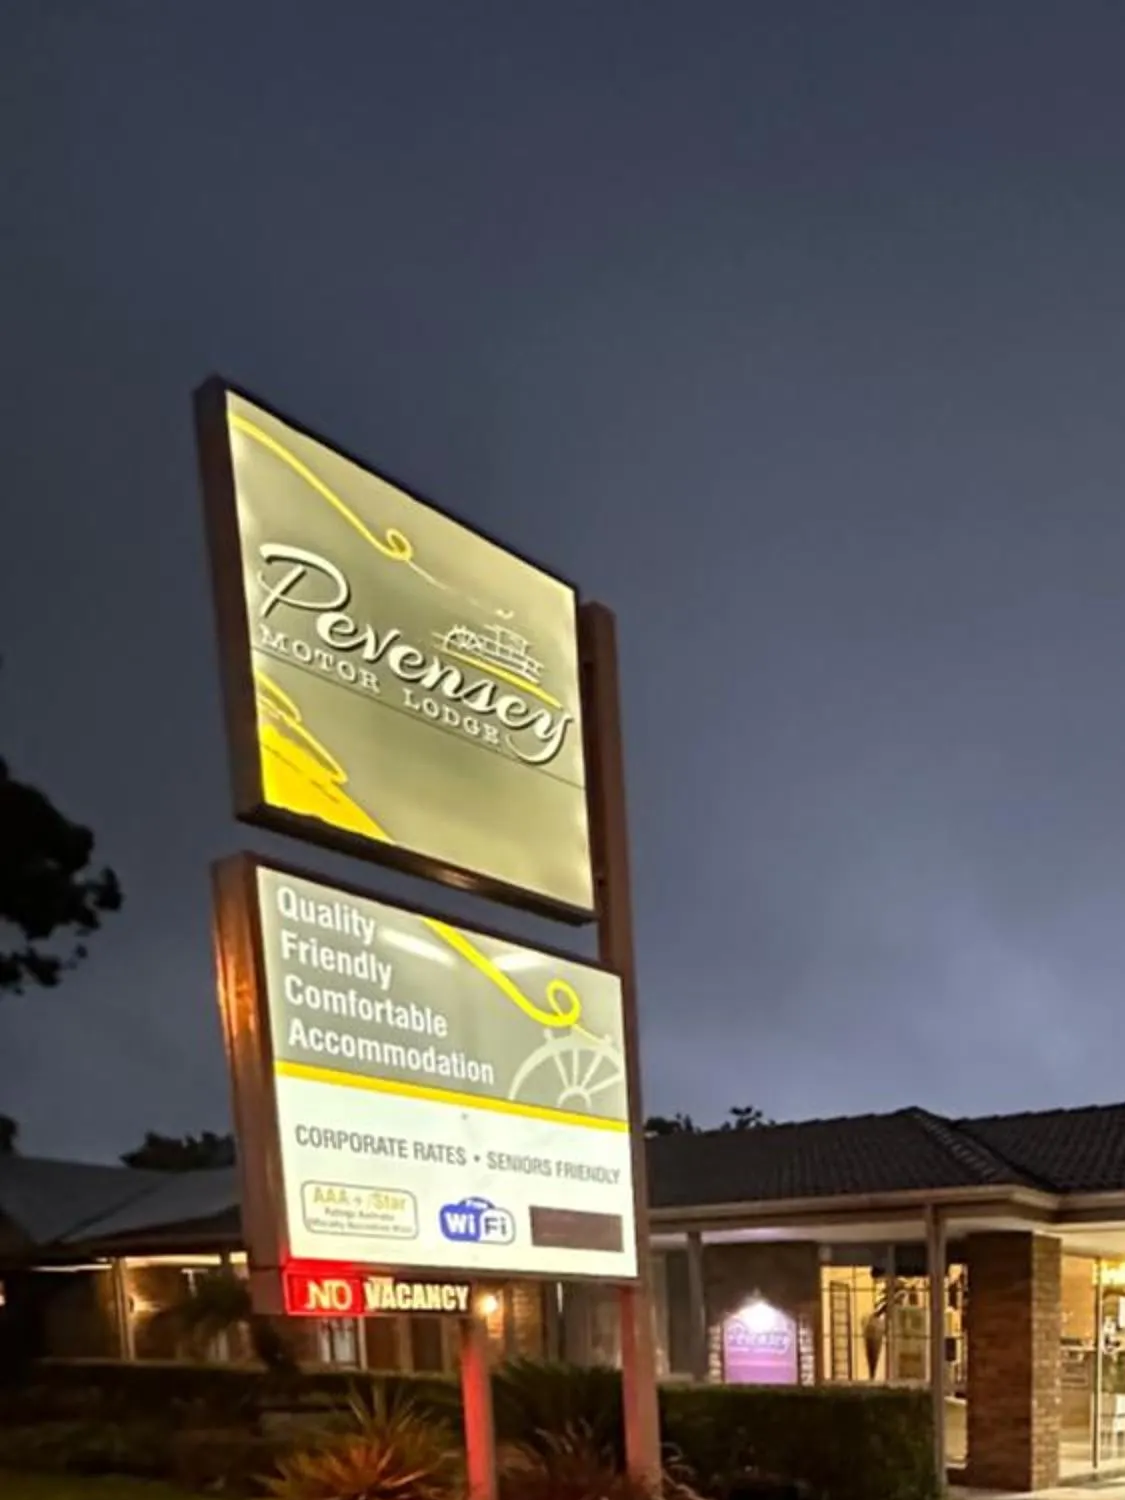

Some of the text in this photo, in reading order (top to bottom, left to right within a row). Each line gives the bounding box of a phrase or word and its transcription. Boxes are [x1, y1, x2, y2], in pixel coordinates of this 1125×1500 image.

[257, 542, 574, 764] Pevensey
[259, 624, 502, 746] MOTOR LODGE
[277, 886, 378, 947] Quality
[281, 931, 393, 991] Friendly
[284, 975, 448, 1038] Comfortable
[288, 1019, 494, 1086] Accommodation
[295, 1124, 621, 1185] CORPORATE RATES SENIORS FRIENDLY
[306, 1276, 470, 1312] NO VACANCY
